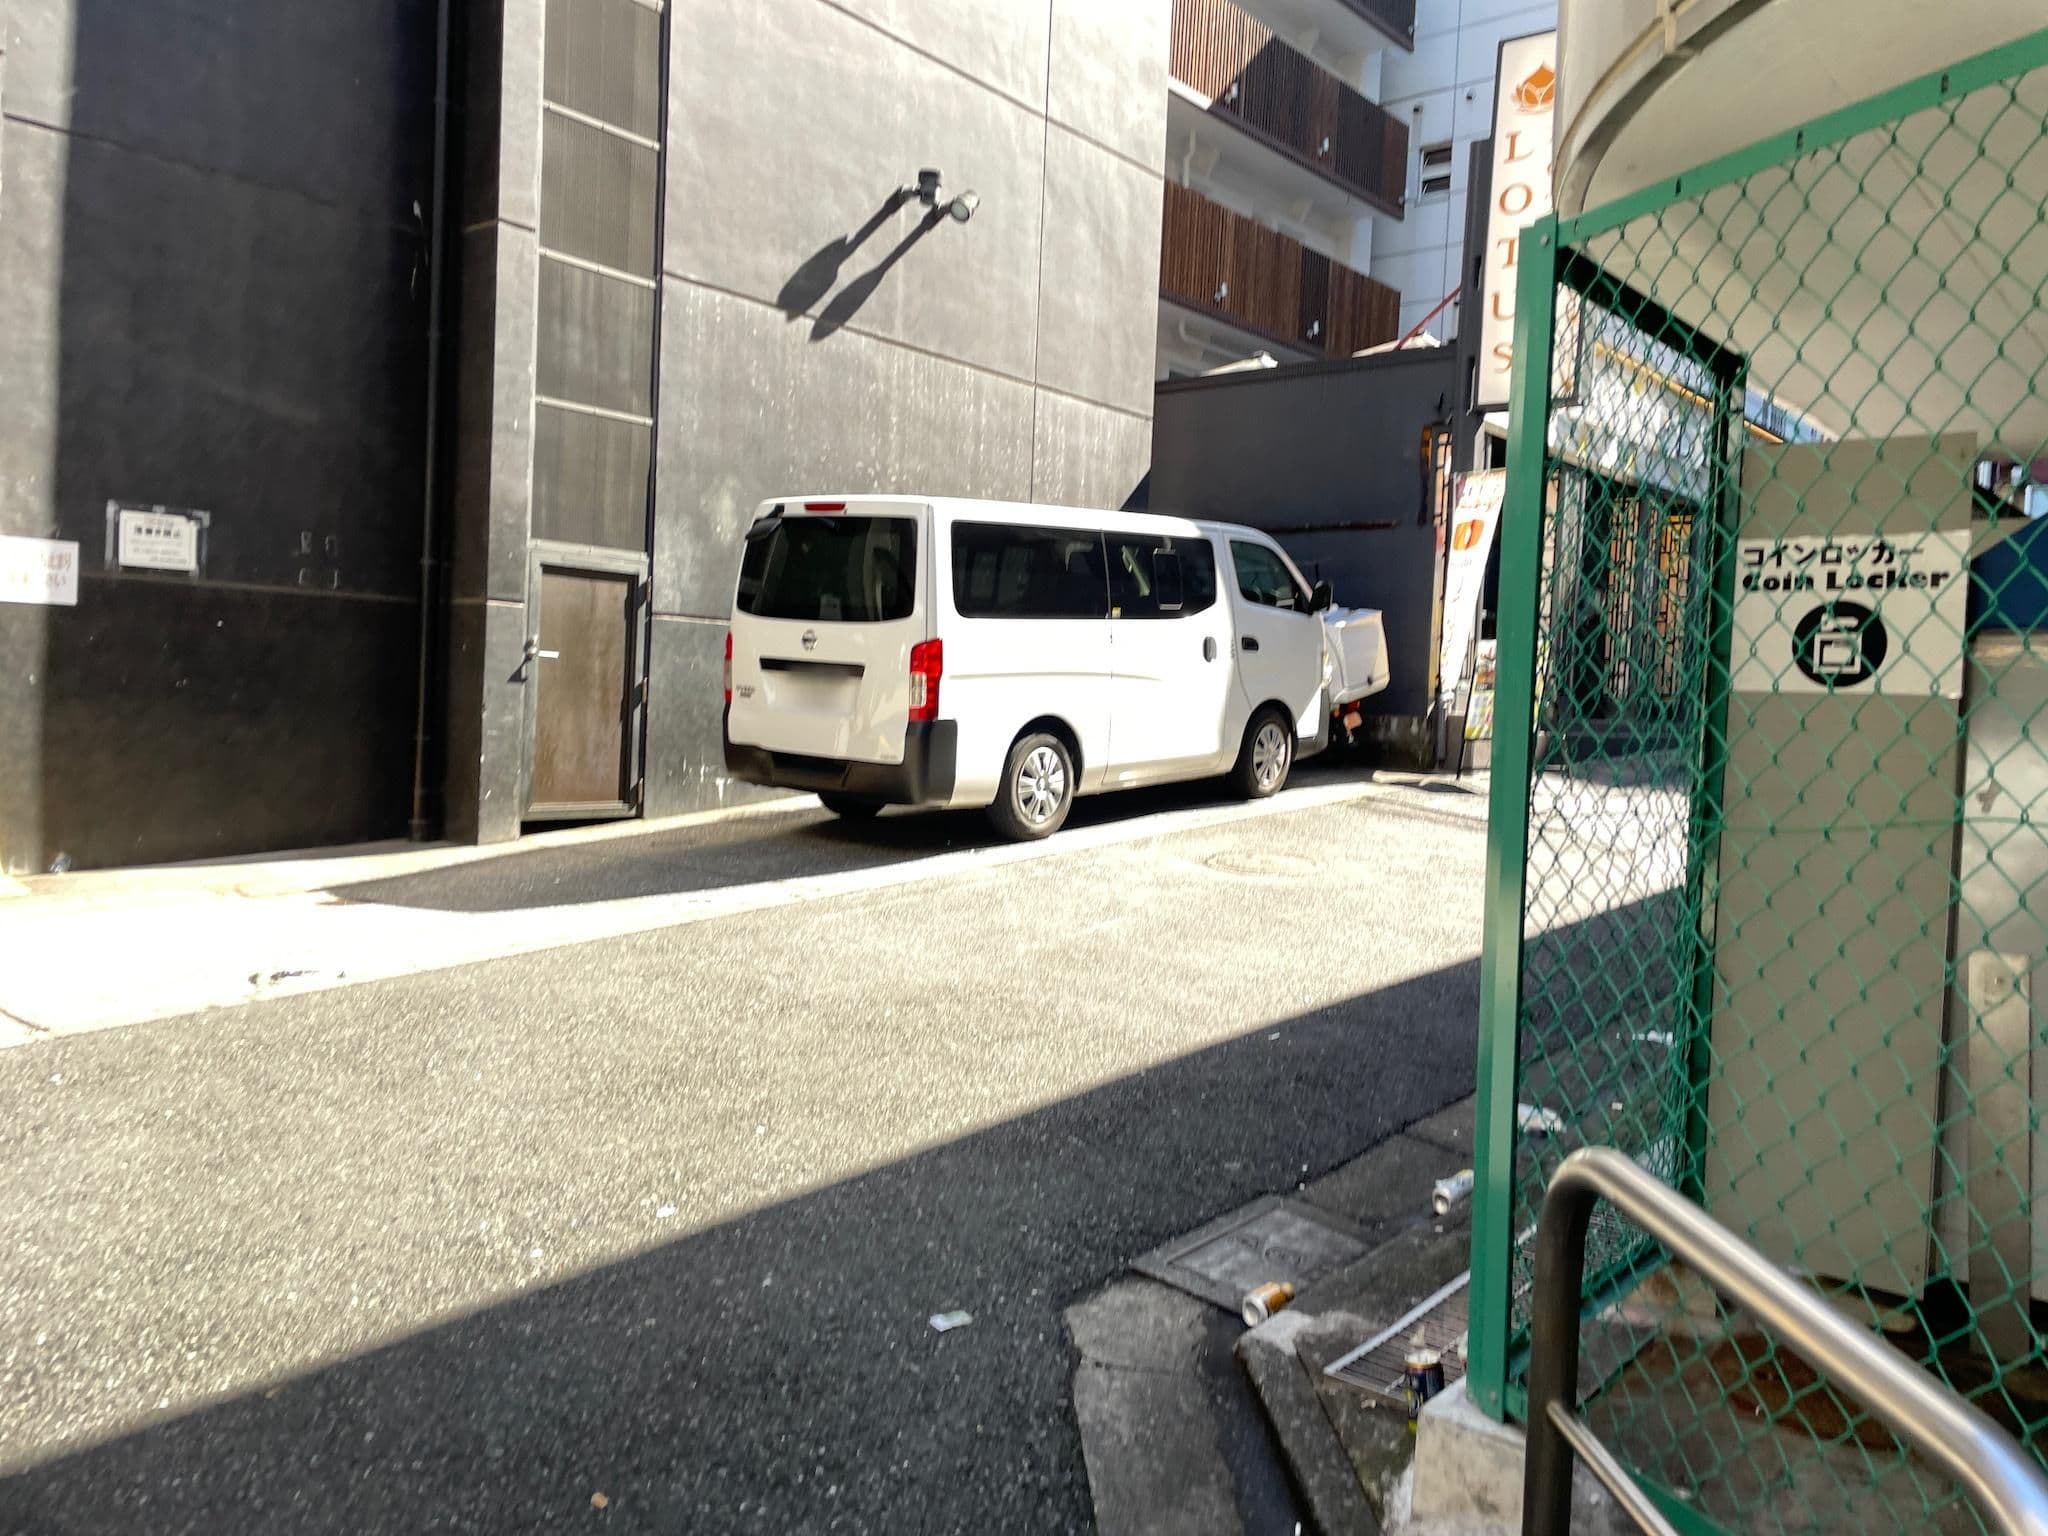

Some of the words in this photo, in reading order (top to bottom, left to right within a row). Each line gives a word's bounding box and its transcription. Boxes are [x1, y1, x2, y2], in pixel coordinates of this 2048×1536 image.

[1492, 131, 1533, 373] LOTUS
[1744, 543, 1924, 567] コインロッカー
[1743, 572, 1814, 592] Coin
[1826, 569, 1950, 592] Locker
